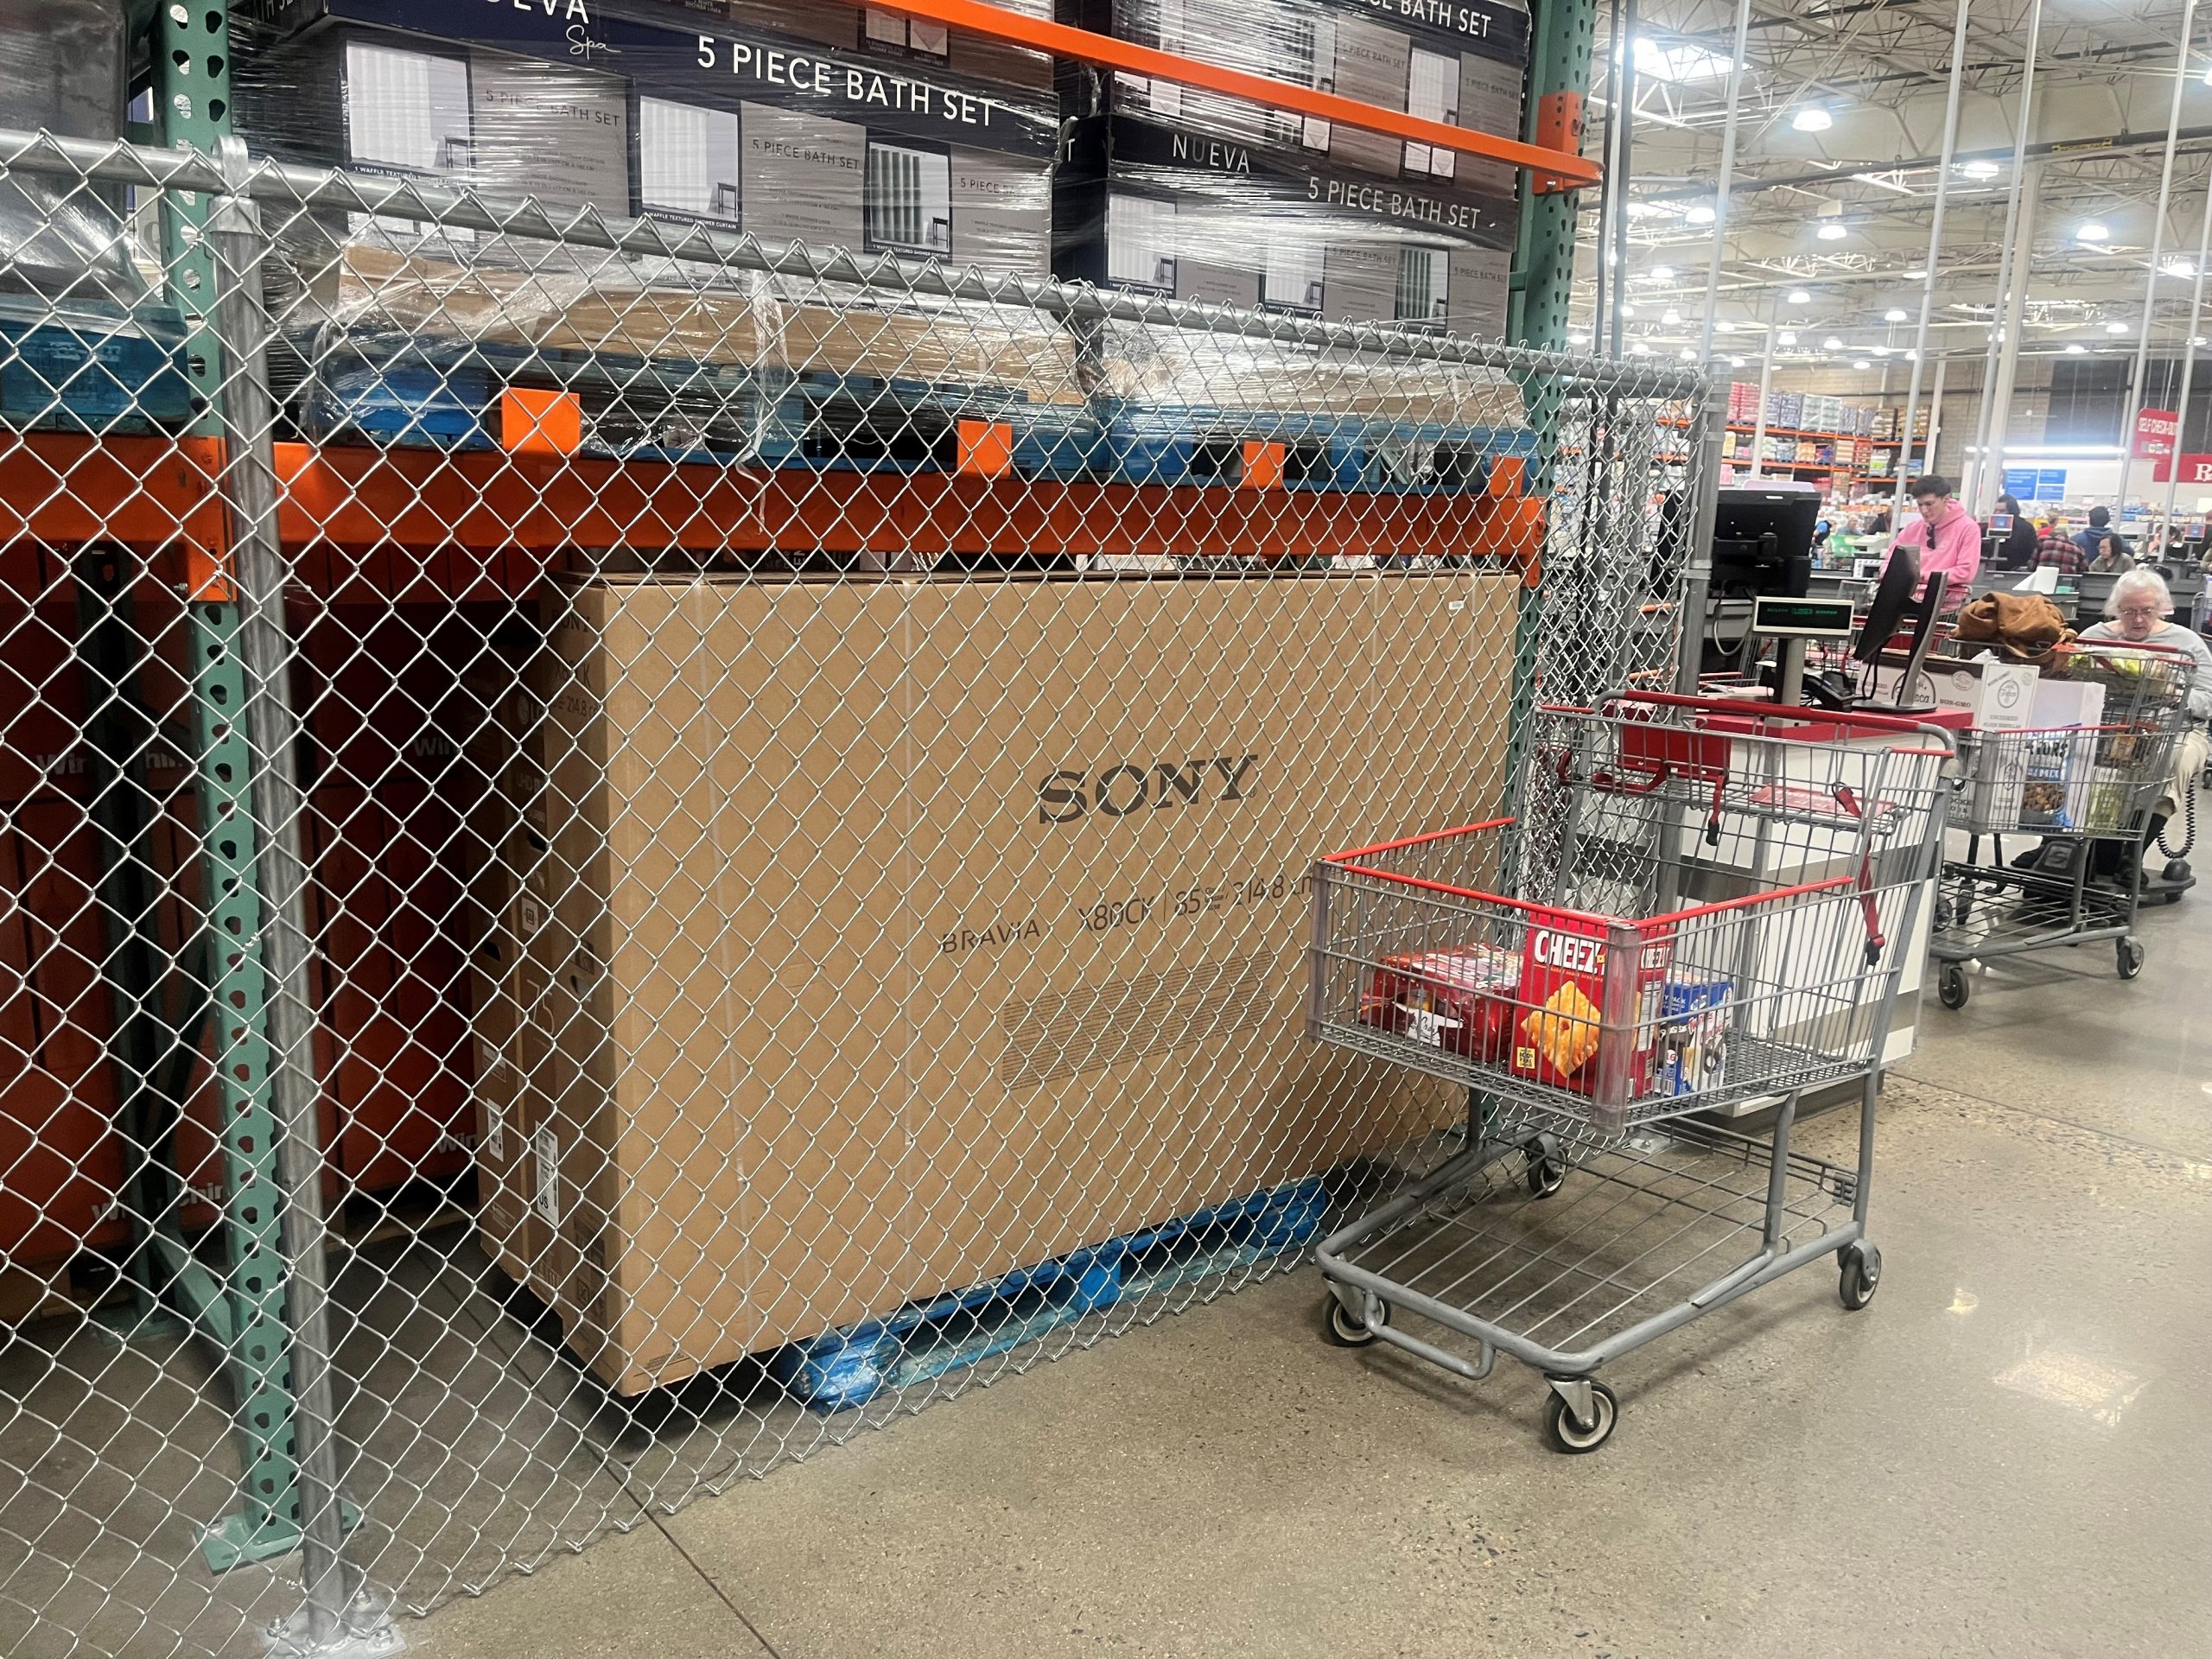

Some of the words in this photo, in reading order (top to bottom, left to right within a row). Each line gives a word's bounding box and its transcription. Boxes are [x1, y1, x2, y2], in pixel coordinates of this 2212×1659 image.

[1401, 0, 1452, 28] BATH
[1458, 8, 1492, 38] SET
[566, 24, 622, 60] Spa
[1392, 58, 1406, 69] SET
[697, 35, 716, 68] 5
[733, 42, 832, 95] PIECE
[846, 69, 930, 114] BATH
[943, 89, 995, 127] SET
[550, 105, 589, 121] BATH
[594, 111, 620, 127] SET
[753, 138, 760, 150] 5
[764, 140, 800, 159] PIECE
[804, 150, 836, 166] BATH
[839, 156, 860, 170] SET
[1173, 133, 1250, 173] NUEVA
[359, 166, 384, 176] WAFFLE
[960, 177, 966, 188] 5
[970, 178, 1000, 194] PIECE
[1308, 176, 1319, 200] 5
[1327, 180, 1384, 213] PIECE
[1391, 194, 1442, 223] BATH
[1447, 204, 1481, 230] SET
[649, 212, 669, 220] WAFFLE
[670, 214, 694, 224] TEXTURED
[695, 218, 715, 227] SHOWER
[716, 221, 737, 230] CURTAIN
[1340, 248, 1362, 259] PIECE
[1363, 252, 1382, 263] BATH
[1459, 268, 1479, 278] PIECE
[1479, 270, 1496, 281] BATH
[1039, 754, 1259, 824] SONY
[1077, 895, 1155, 932] X80CK
[1174, 888, 1201, 916] 85
[1233, 874, 1285, 906] 2148
[942, 918, 1041, 954] BRAVIA
[539, 1193, 550, 1210] US
